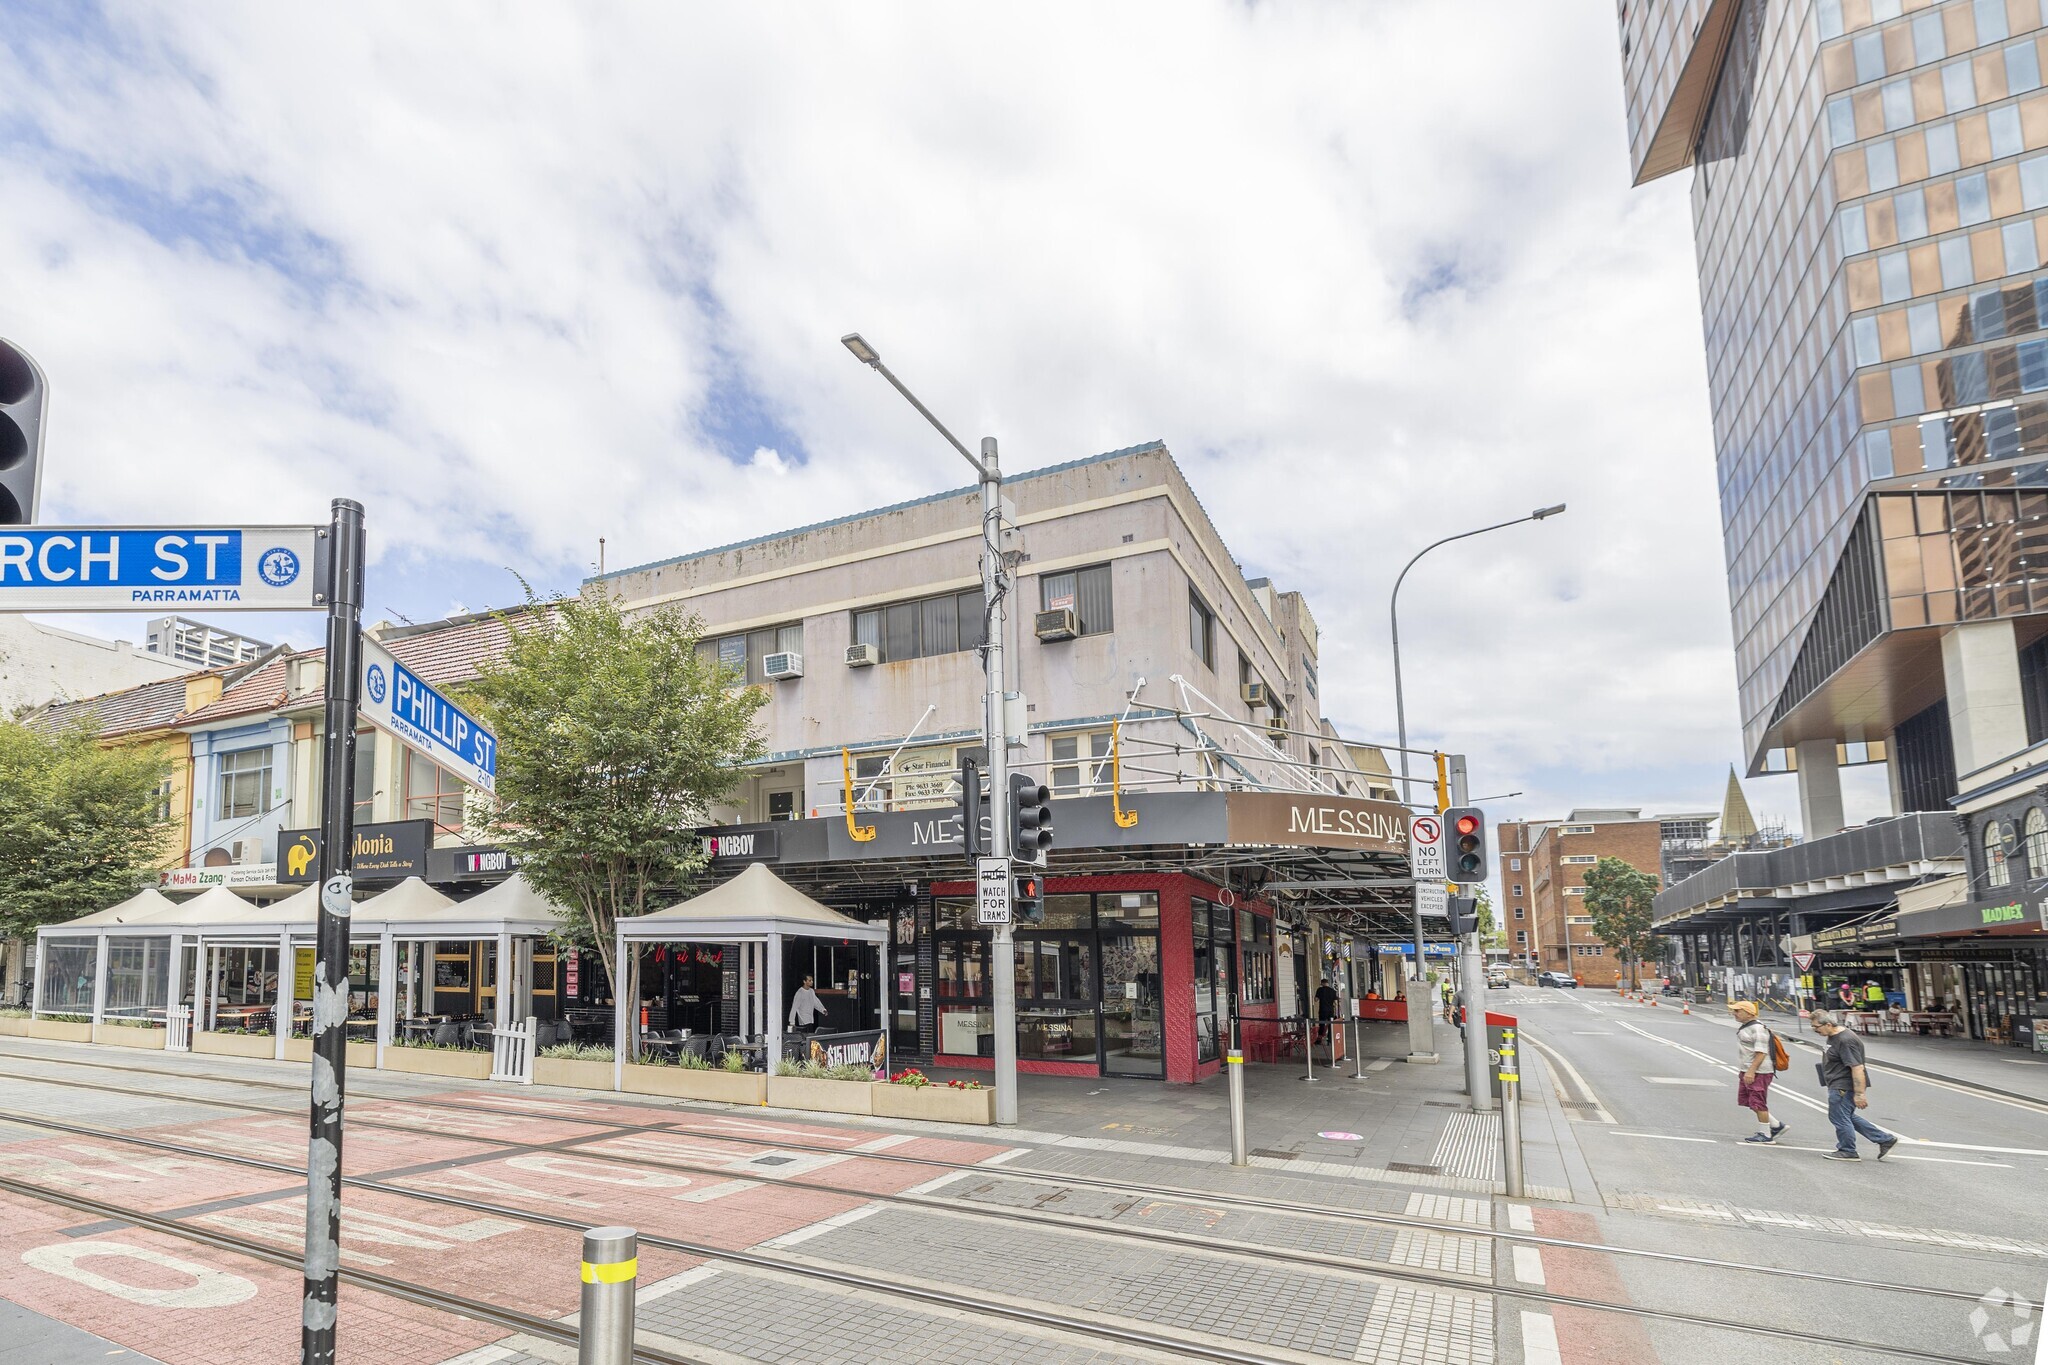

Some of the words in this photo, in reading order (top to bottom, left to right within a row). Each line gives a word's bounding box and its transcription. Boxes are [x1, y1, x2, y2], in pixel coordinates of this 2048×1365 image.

[150, 534, 230, 581] ST
[131, 589, 241, 602] PARRAMATTA
[397, 670, 468, 752] PHILLIP
[474, 730, 493, 771] ST
[391, 716, 433, 752] PARRAMATTA
[912, 762, 924, 770] Star
[925, 759, 951, 769] Financial
[477, 769, 491, 789] 2-10
[1288, 806, 1407, 843] MESSINA
[1418, 846, 1437, 857] NO
[1417, 867, 1442, 875] TURN
[172, 873, 197, 885] MaMa
[199, 871, 224, 886] Zzang
[982, 887, 1006, 897] WATCH
[1418, 887, 1446, 895] CONSTRUCTION
[982, 899, 1006, 909] FOR
[1420, 895, 1443, 903] VEHICLES
[1420, 903, 1443, 911] EXCEPTED
[982, 911, 1006, 920] TRAMS
[1036, 1023, 1073, 1032] MESSINA
[827, 1044, 843, 1070] $15
[843, 1041, 870, 1065] LUNCH
